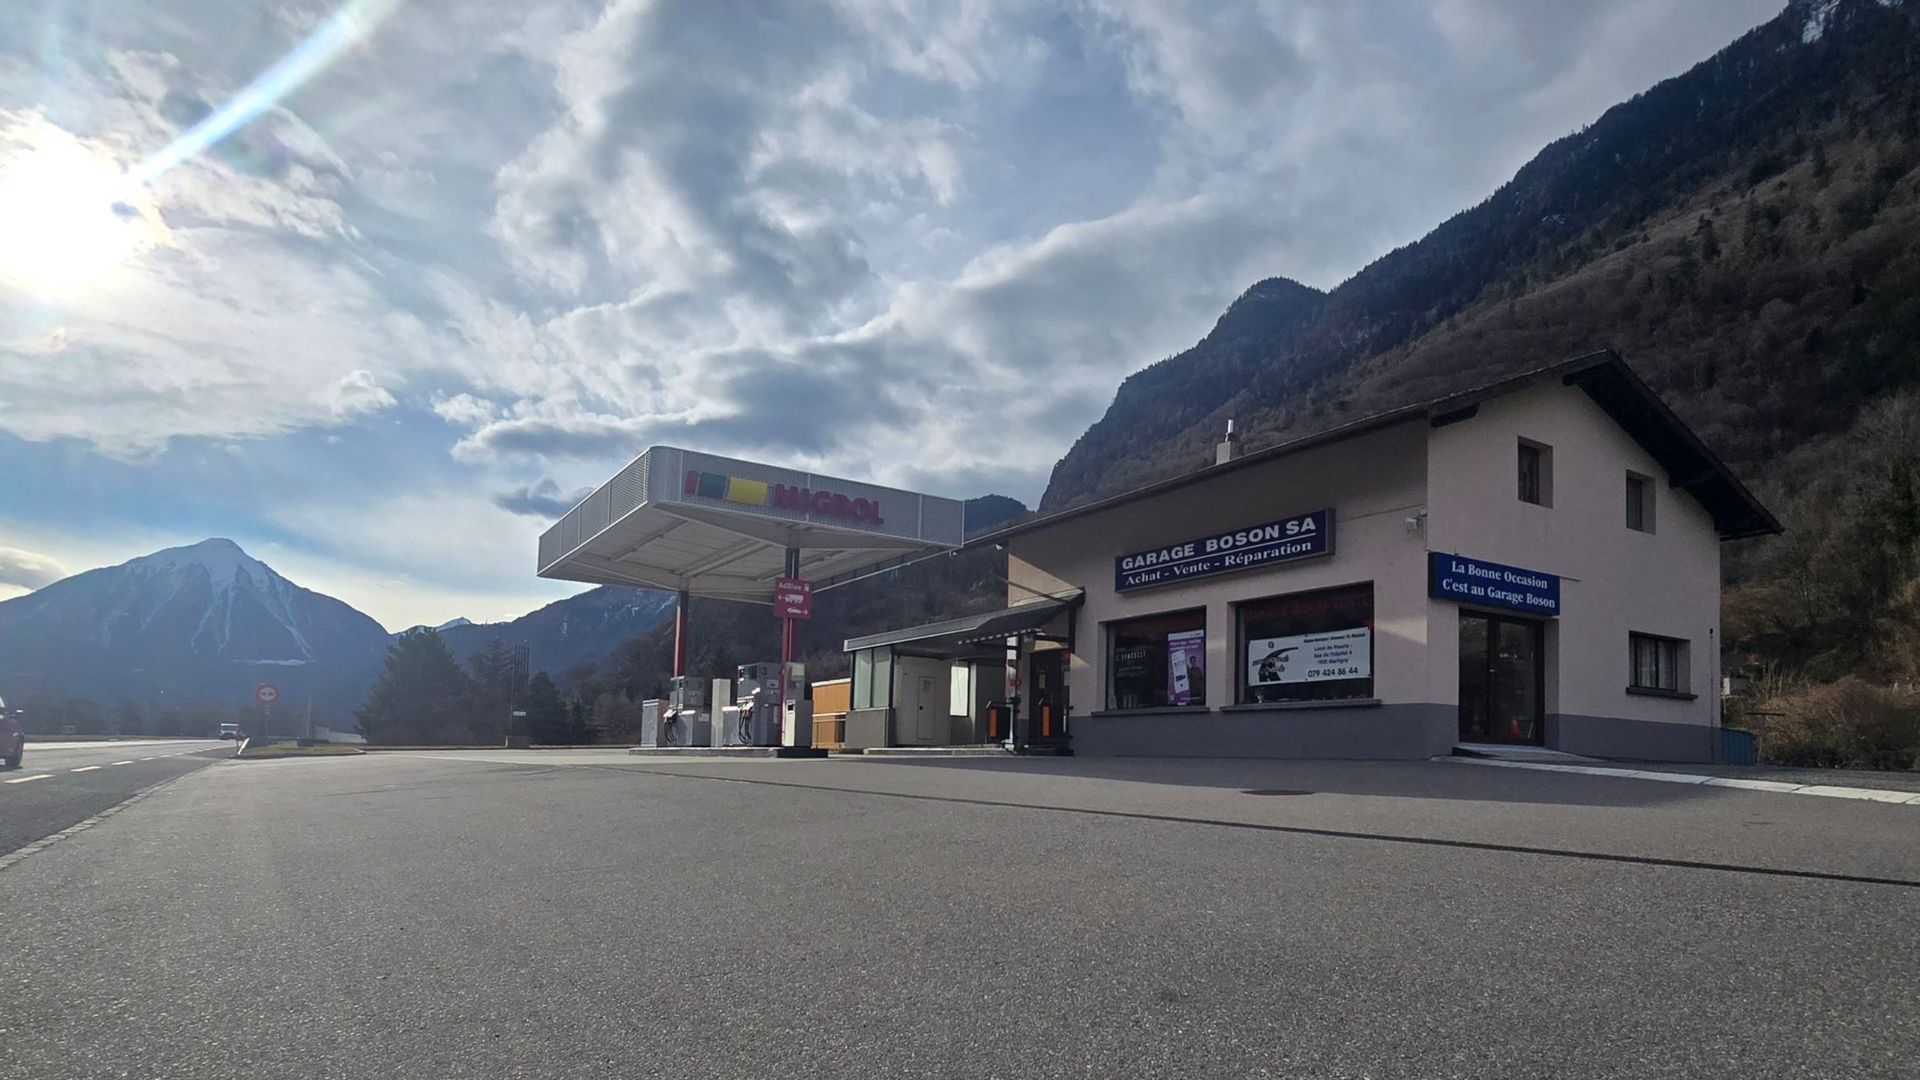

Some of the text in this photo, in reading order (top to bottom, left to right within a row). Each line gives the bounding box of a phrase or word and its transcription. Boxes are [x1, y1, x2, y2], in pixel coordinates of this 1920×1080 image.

[773, 483, 884, 525] MIGROL
[1122, 517, 1316, 570] GARAGE BOSON SA
[1125, 571, 1161, 586] Achat
[1173, 561, 1211, 576] Vente
[1224, 541, 1311, 566] Réparation
[1452, 561, 1548, 589] La Bonne Occasion
[778, 582, 801, 590] AdBlue
[1442, 578, 1555, 608] C'est au Garage Boson
[1308, 669, 1321, 677] 079
[1322, 668, 1335, 676] 424
[1348, 666, 1358, 674] 44
